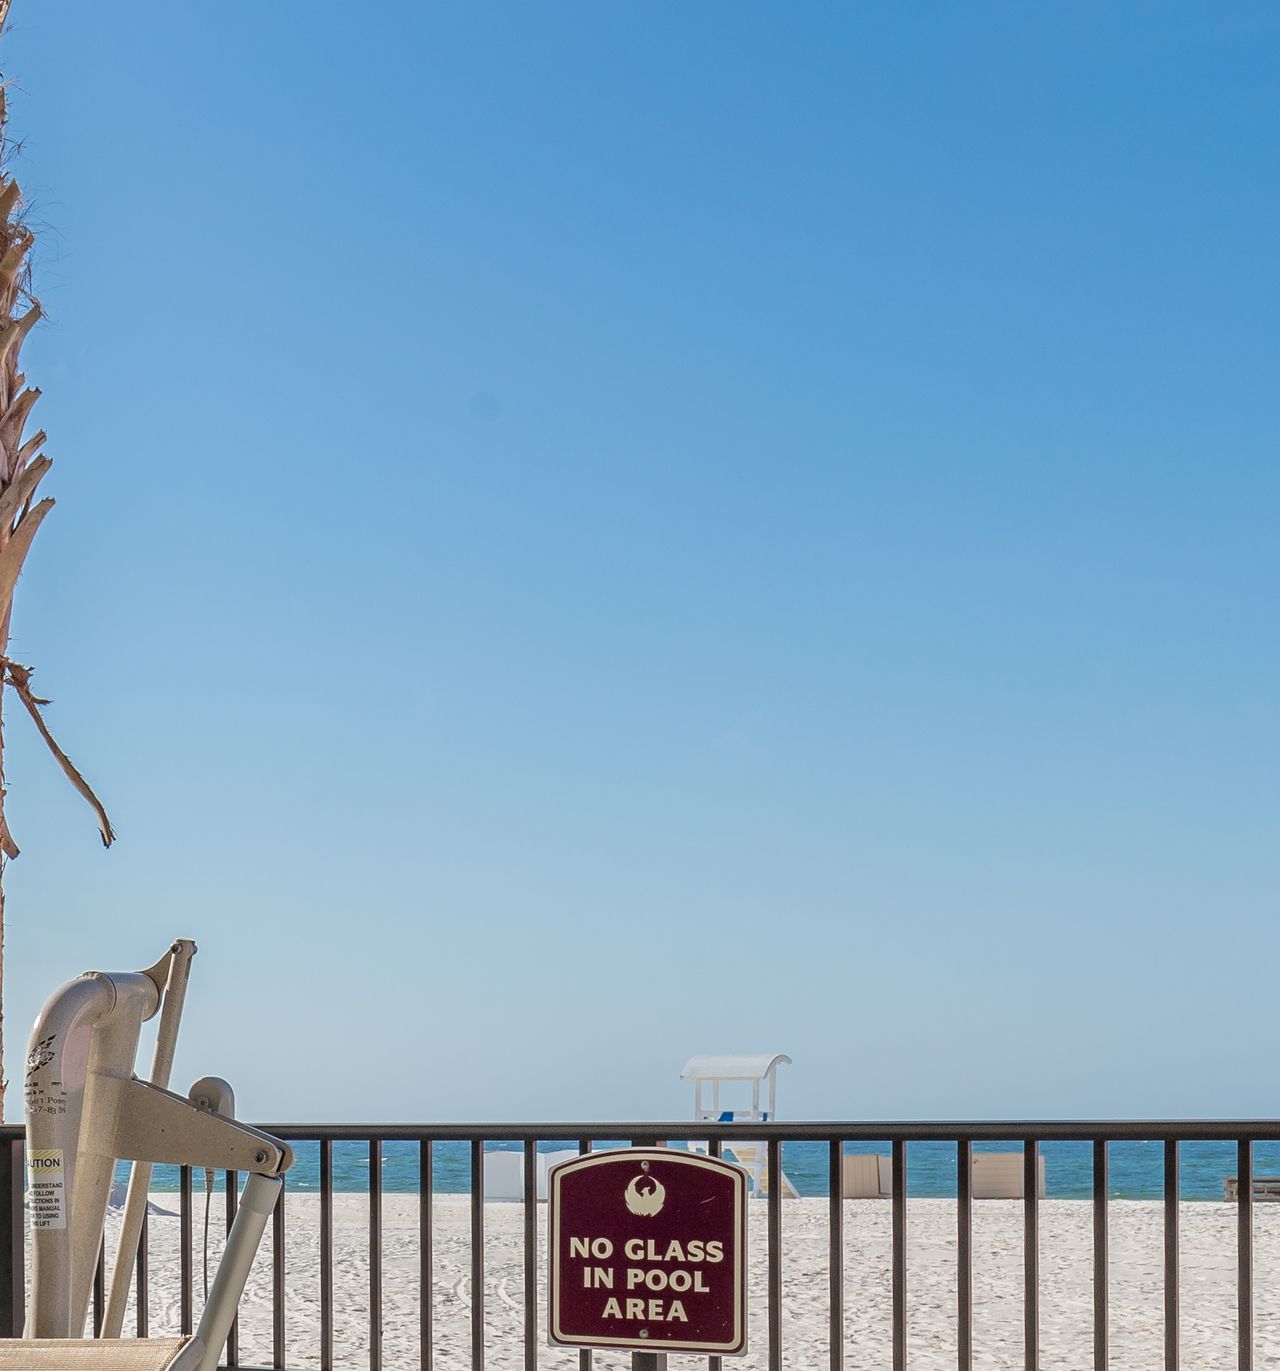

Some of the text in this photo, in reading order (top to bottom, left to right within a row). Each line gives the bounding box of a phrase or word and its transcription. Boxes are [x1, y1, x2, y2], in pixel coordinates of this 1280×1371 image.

[29, 1158, 61, 1168] UTION
[569, 1237, 724, 1263] NO GLASS
[583, 1267, 710, 1293] IN POOL
[601, 1297, 688, 1322] AREA
